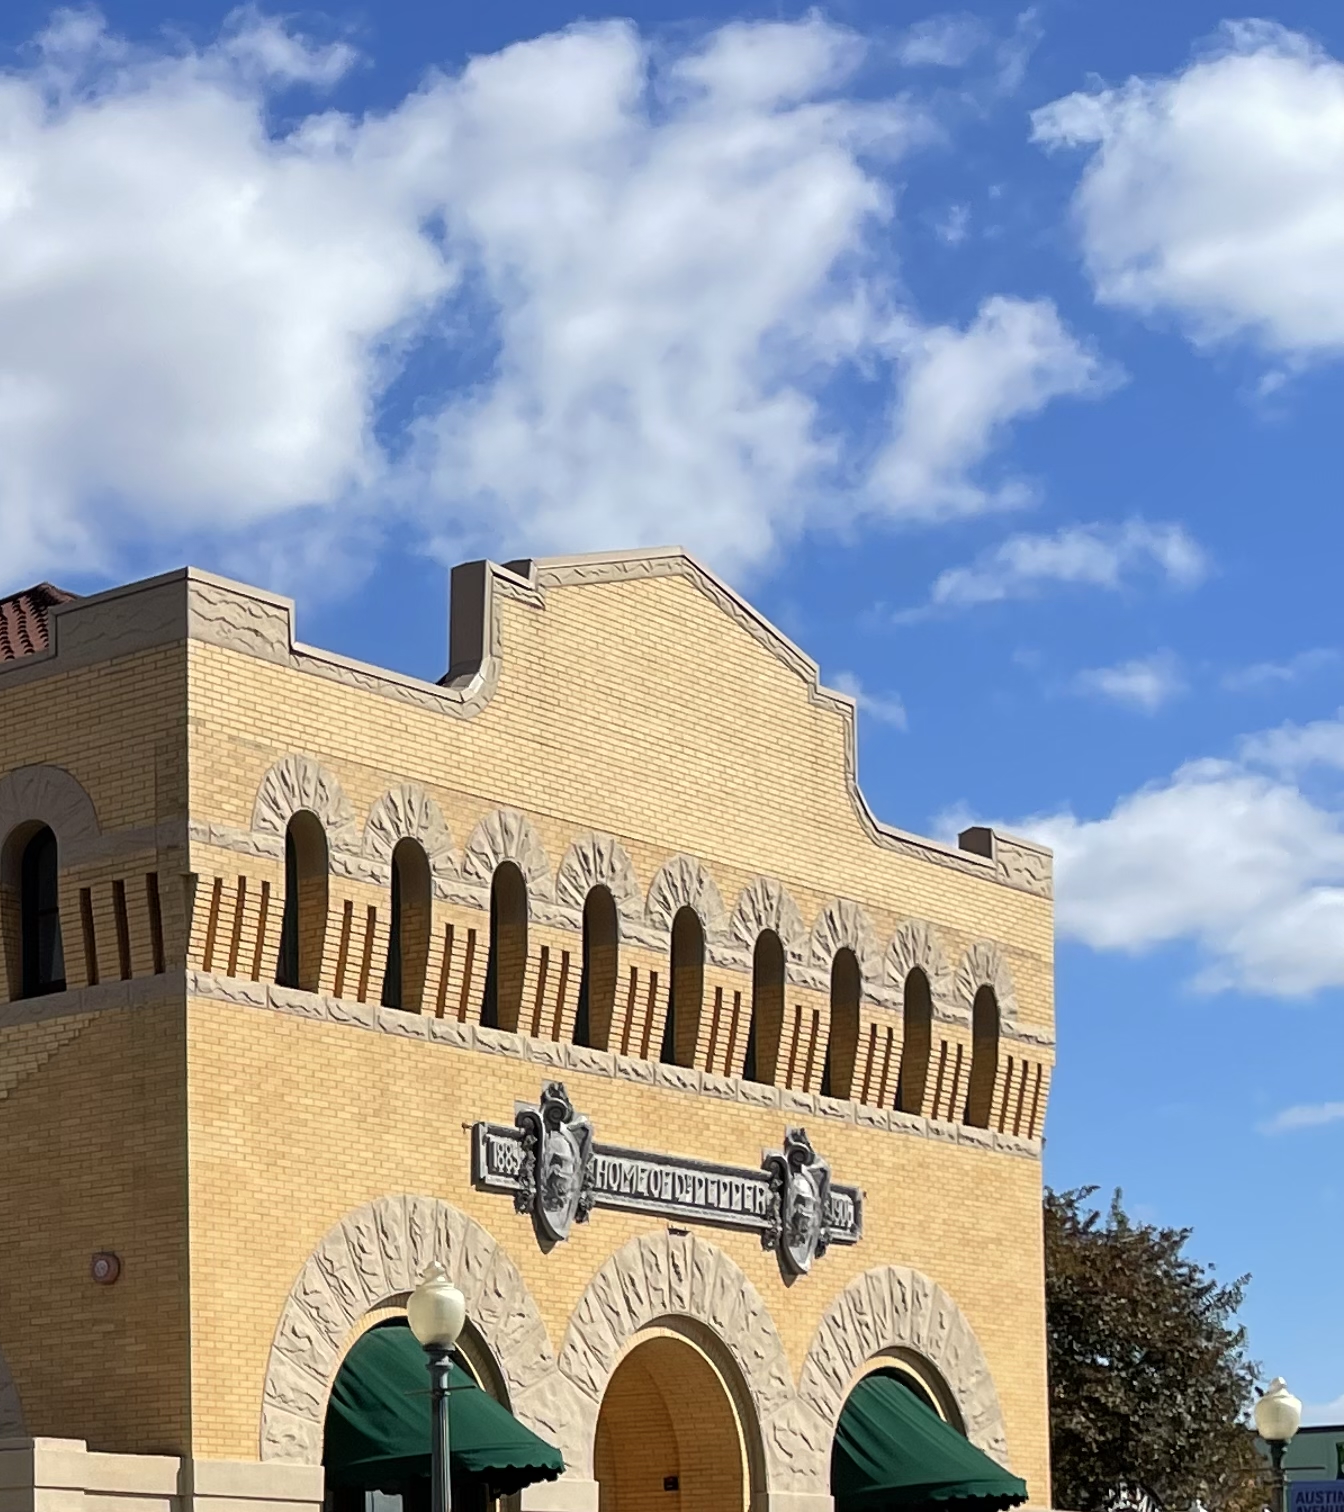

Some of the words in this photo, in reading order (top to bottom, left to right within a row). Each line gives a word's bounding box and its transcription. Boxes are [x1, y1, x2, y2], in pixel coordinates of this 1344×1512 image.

[595, 1157, 649, 1197] HOME
[650, 1168, 672, 1200] OF
[695, 1174, 767, 1215] PEPPER
[1295, 1491, 1344, 1504] AUSTIN
